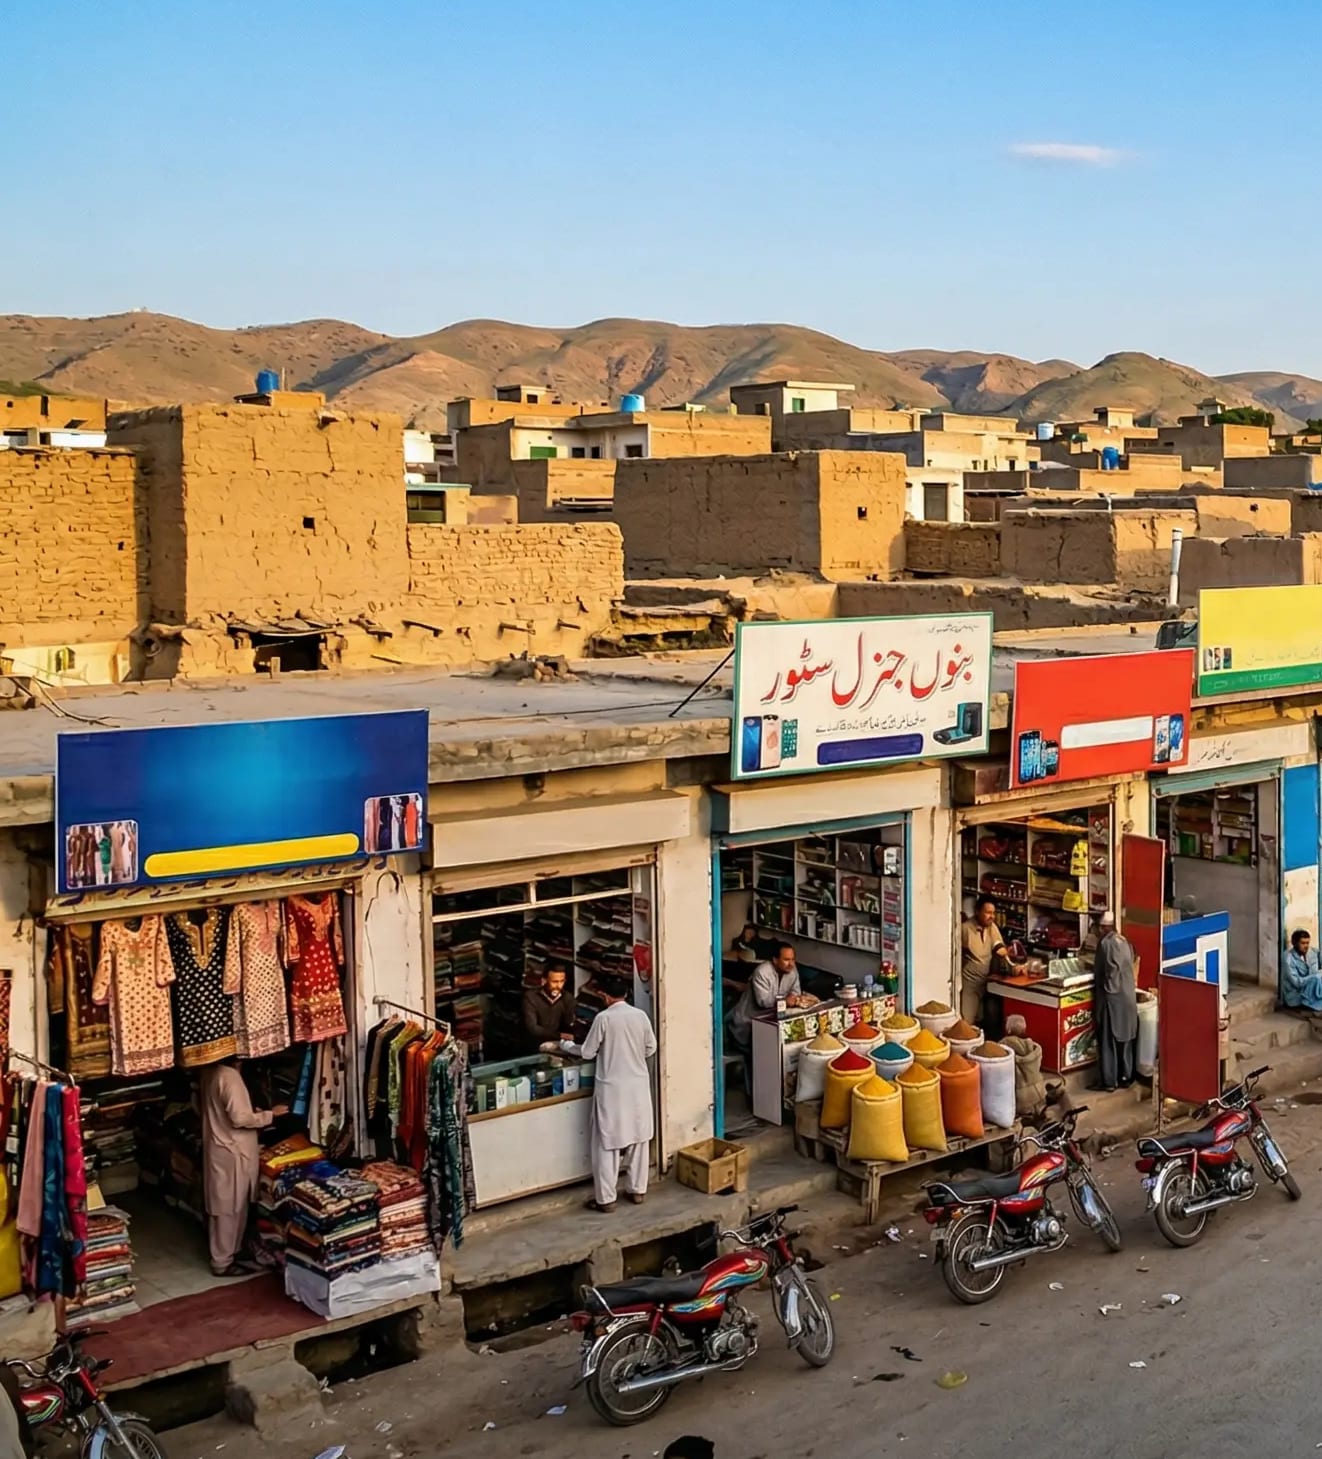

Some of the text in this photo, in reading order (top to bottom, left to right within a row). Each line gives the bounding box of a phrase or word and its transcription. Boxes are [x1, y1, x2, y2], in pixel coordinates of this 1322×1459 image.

[760, 631, 974, 709] بنوں جنرل سٹور
